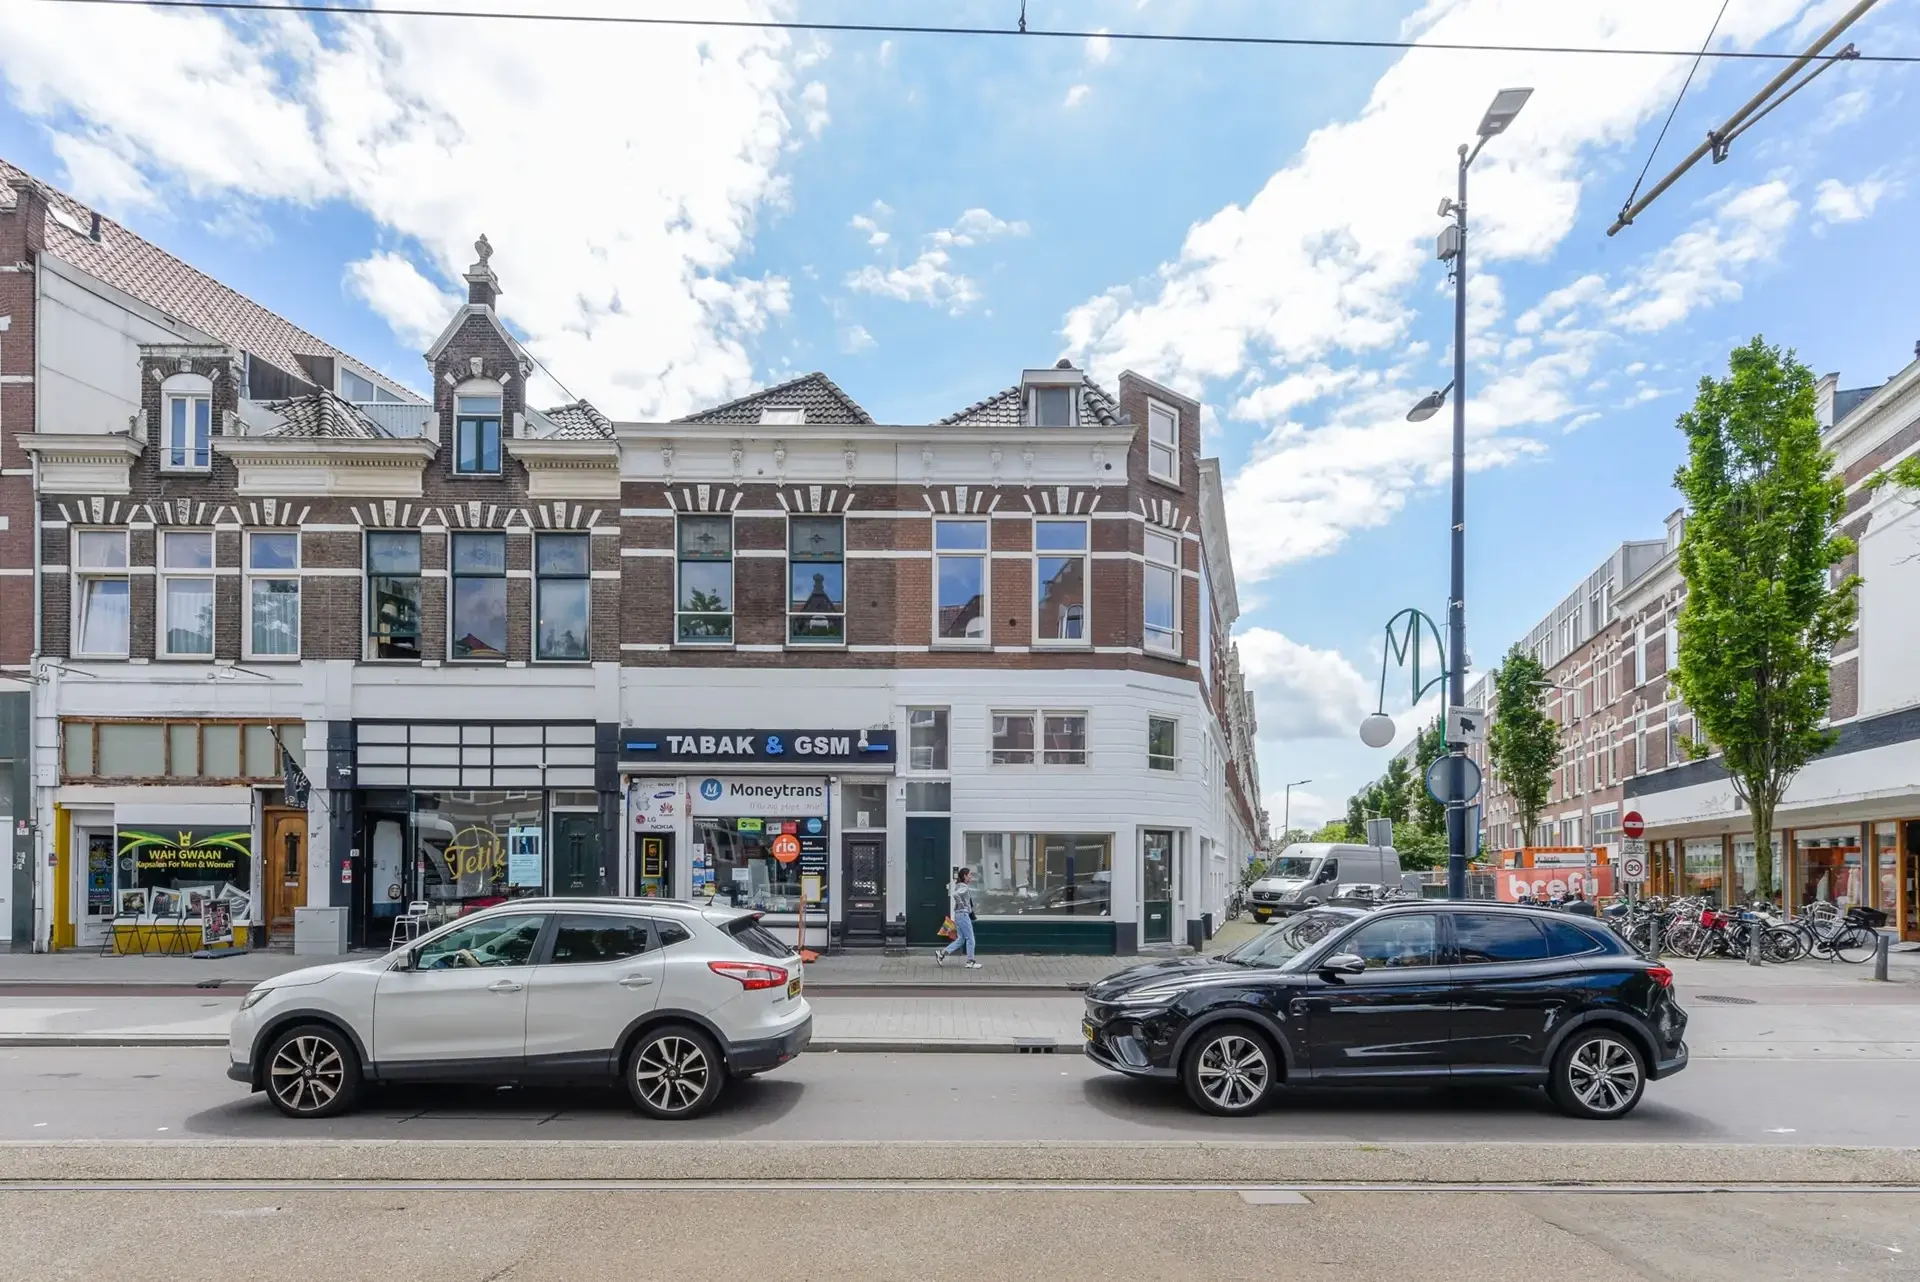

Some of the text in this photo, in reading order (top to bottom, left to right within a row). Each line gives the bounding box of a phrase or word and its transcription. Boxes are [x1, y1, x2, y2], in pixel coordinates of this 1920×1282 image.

[666, 735, 850, 755] TABAK & GSM
[730, 783, 823, 800] Moneytrans
[775, 838, 797, 853] ria
[149, 850, 221, 860] WAH GWAAN
[136, 861, 167, 869] Kapsalon
[1627, 864, 1640, 872] 30
